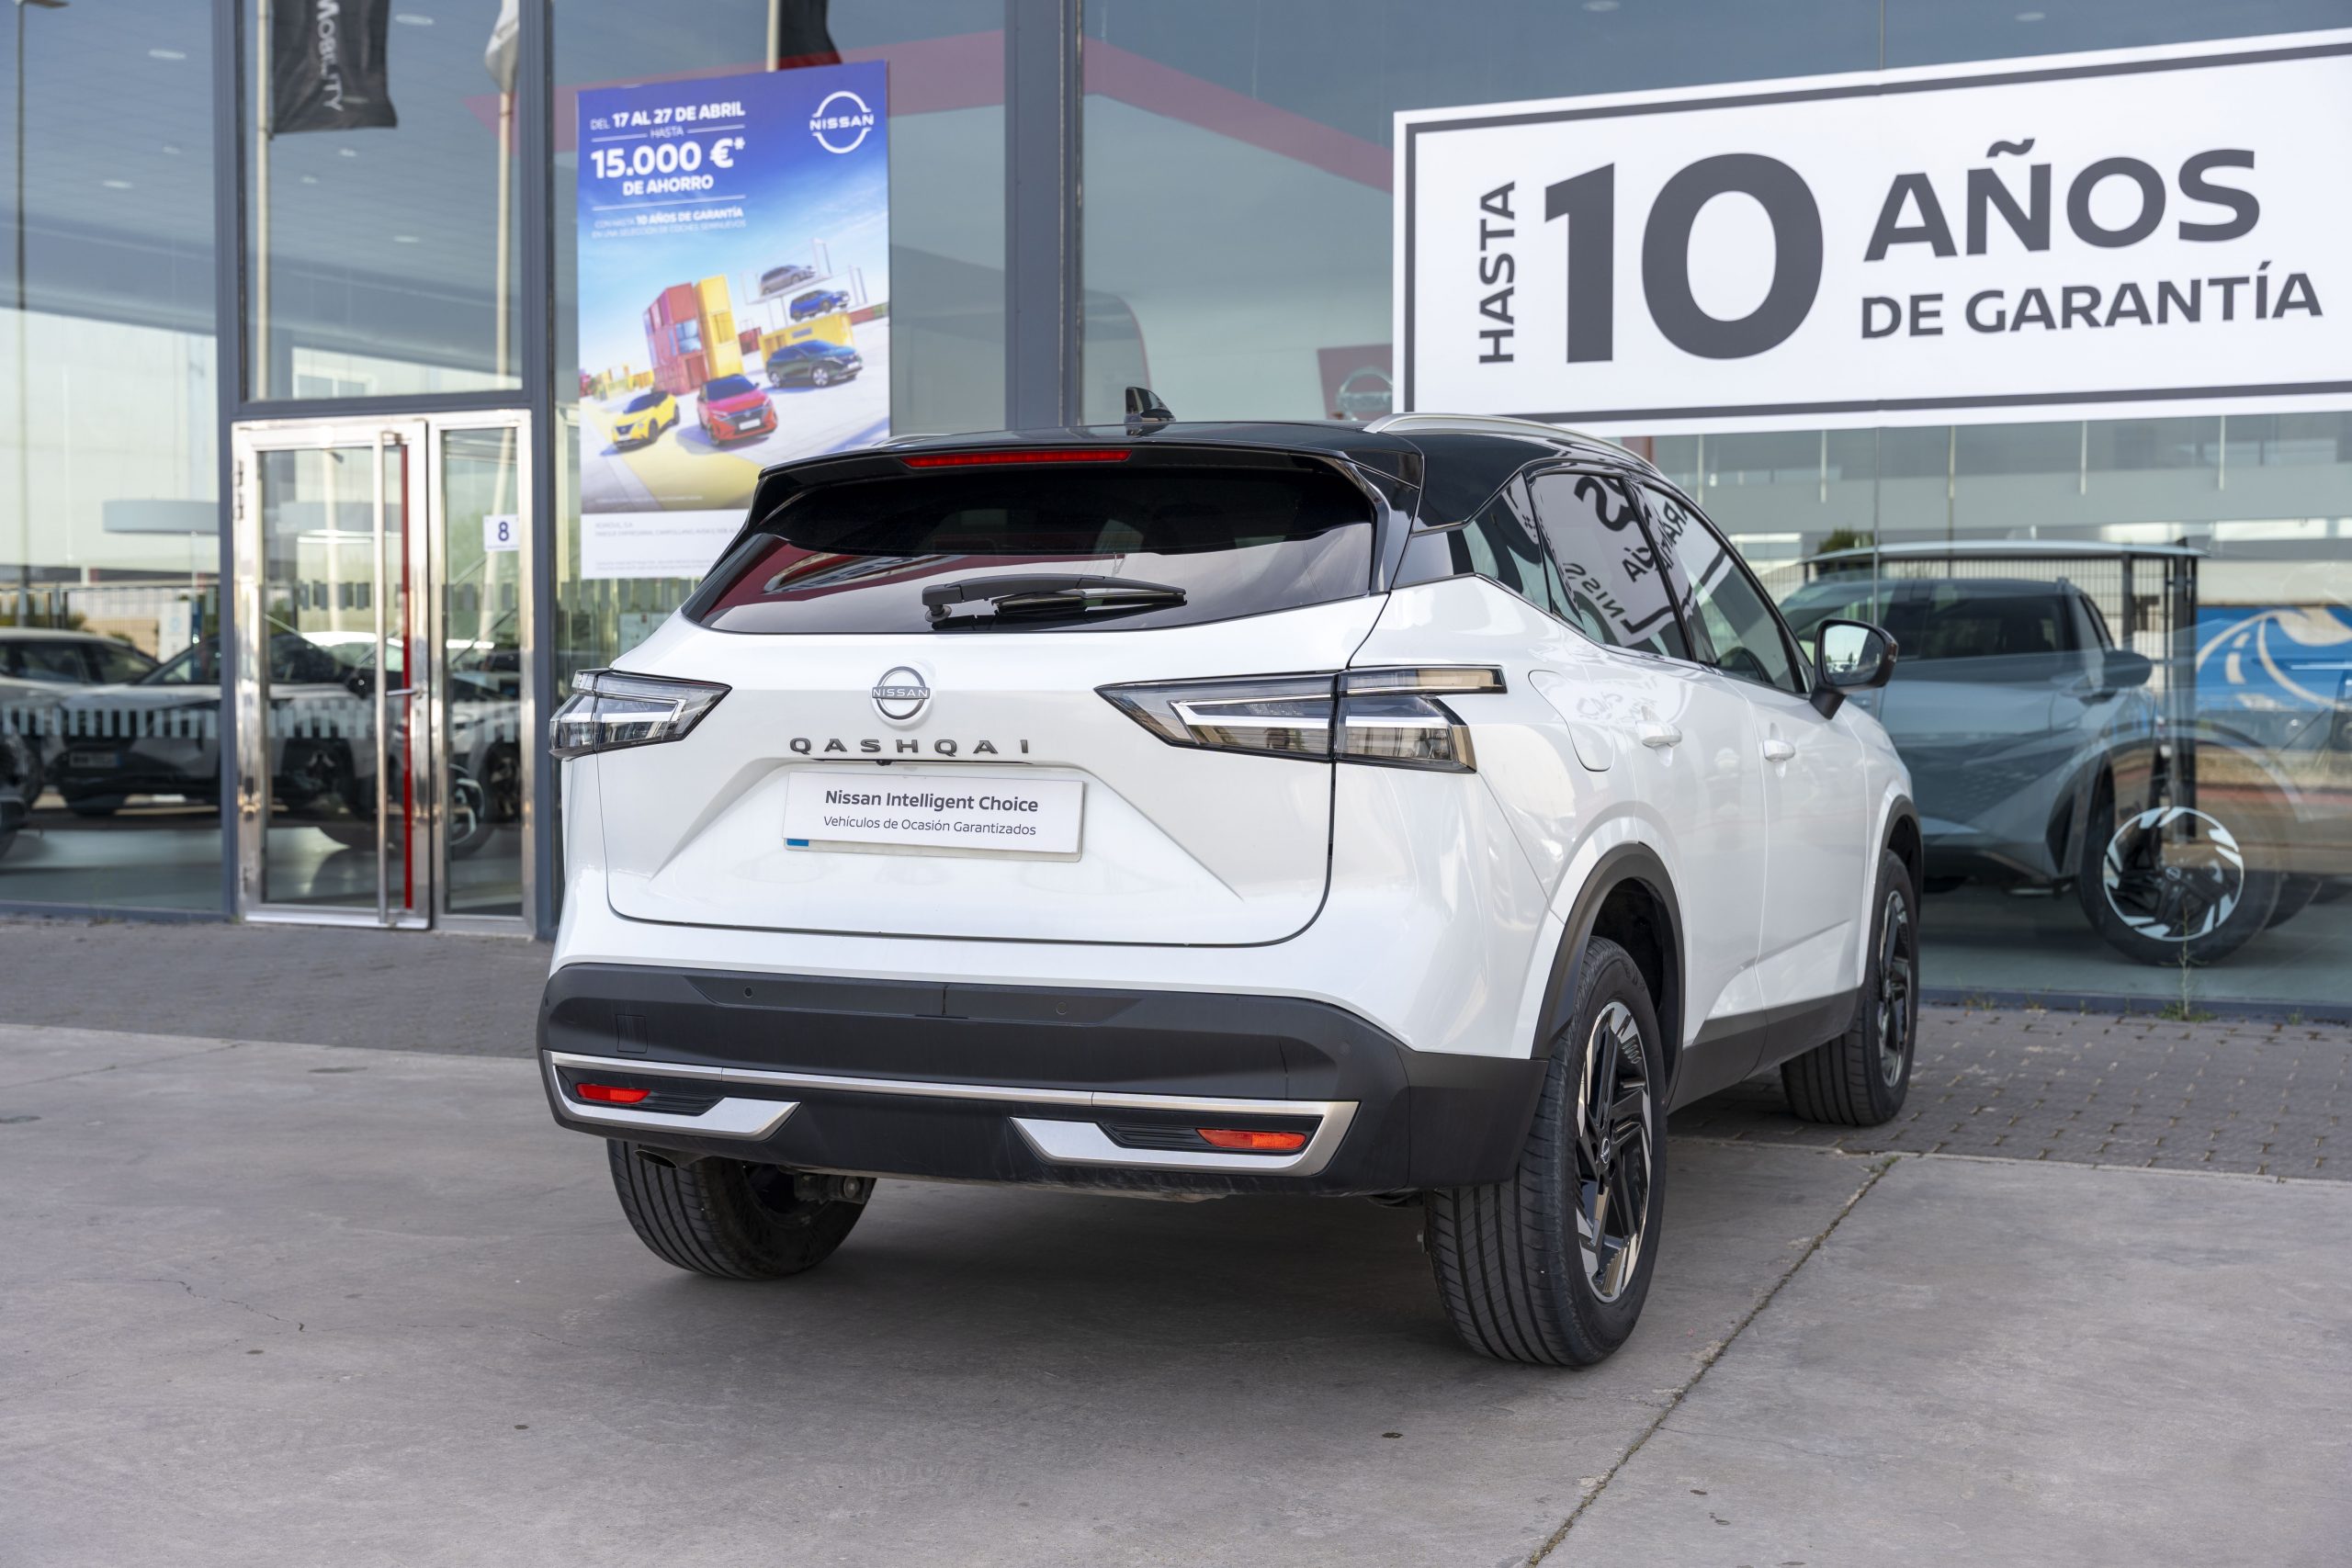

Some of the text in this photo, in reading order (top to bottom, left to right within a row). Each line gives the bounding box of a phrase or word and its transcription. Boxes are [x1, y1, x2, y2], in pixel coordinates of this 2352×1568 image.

[591, 101, 745, 130] DEL 17 AL 27 DE ABRIL
[809, 114, 874, 131] NISSAN
[650, 126, 684, 139] HASTA
[591, 141, 701, 178] 15.000
[623, 175, 714, 196] DE AHORRO
[650, 211, 676, 224] AÑOS
[678, 210, 692, 222] DE
[1544, 138, 2262, 365] 10 AÑOS
[1478, 180, 1516, 365] HASTA
[1860, 260, 2324, 340] DE GARANTÍA
[498, 521, 510, 542] 8
[872, 687, 930, 699] NISSAN
[789, 737, 1030, 758] QASHQAI
[825, 790, 1038, 815] Nissan Intelligent Choice
[824, 816, 1036, 836] Vehículos de Ocasión Garantizados
